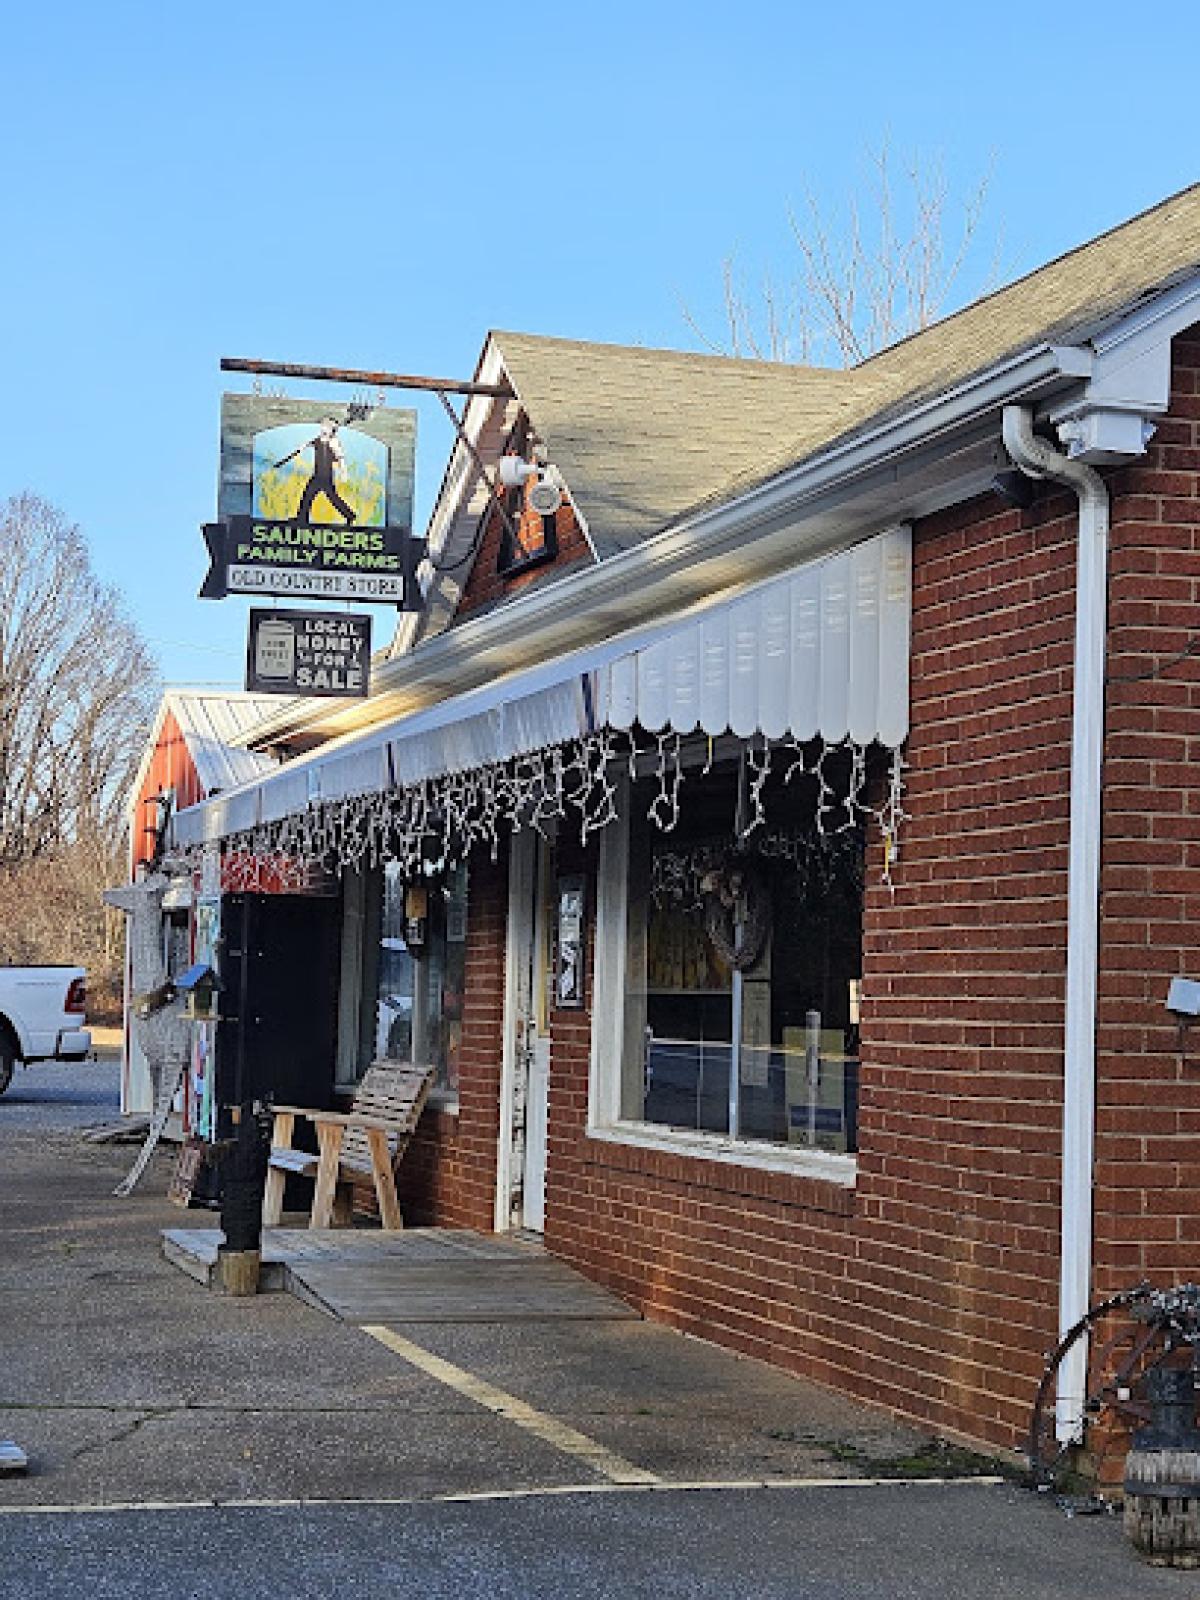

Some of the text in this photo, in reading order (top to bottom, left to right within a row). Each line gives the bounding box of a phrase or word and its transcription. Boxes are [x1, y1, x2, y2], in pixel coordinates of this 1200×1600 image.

[252, 525, 384, 551] SAUNDERS
[237, 543, 401, 569] FAMILY FARMS
[231, 570, 399, 595] OLD COUNTRY STORE
[305, 620, 359, 636] LOCAL
[297, 635, 363, 653] HONEY
[297, 667, 363, 689] SALE
